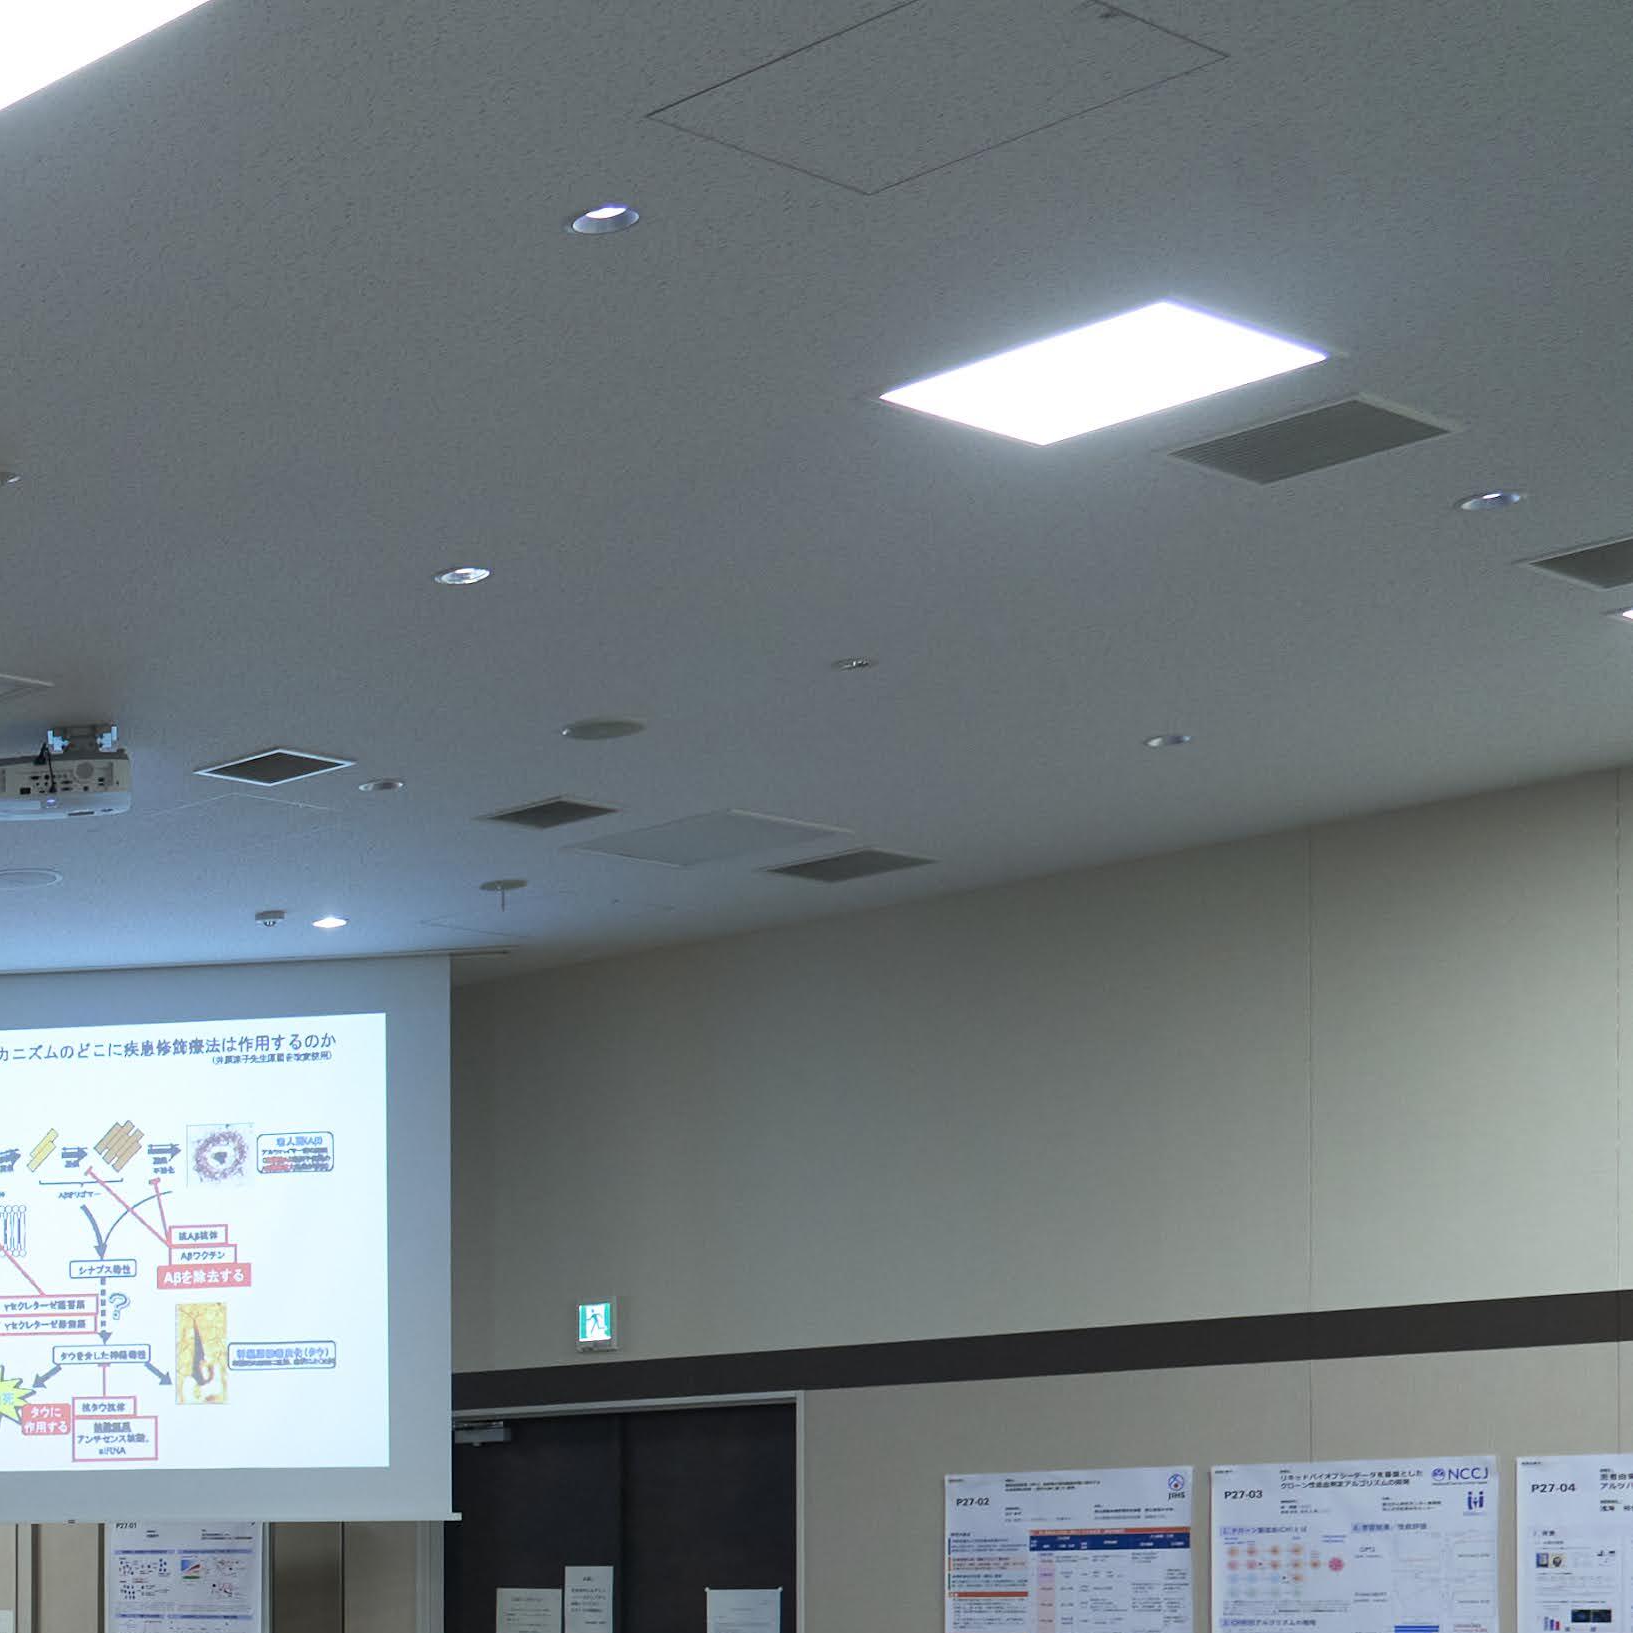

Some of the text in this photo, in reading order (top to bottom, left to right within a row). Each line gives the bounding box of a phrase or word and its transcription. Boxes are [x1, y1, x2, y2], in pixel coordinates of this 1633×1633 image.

[163, 1268, 245, 1285] Aβを除去する
[24, 1420, 69, 1435] 作用する
[1448, 1467, 1488, 1480] NCCJ
[1531, 1483, 1576, 1493] P27-04
[1224, 1489, 1264, 1500] P27-03
[956, 1497, 990, 1507] P27-02
